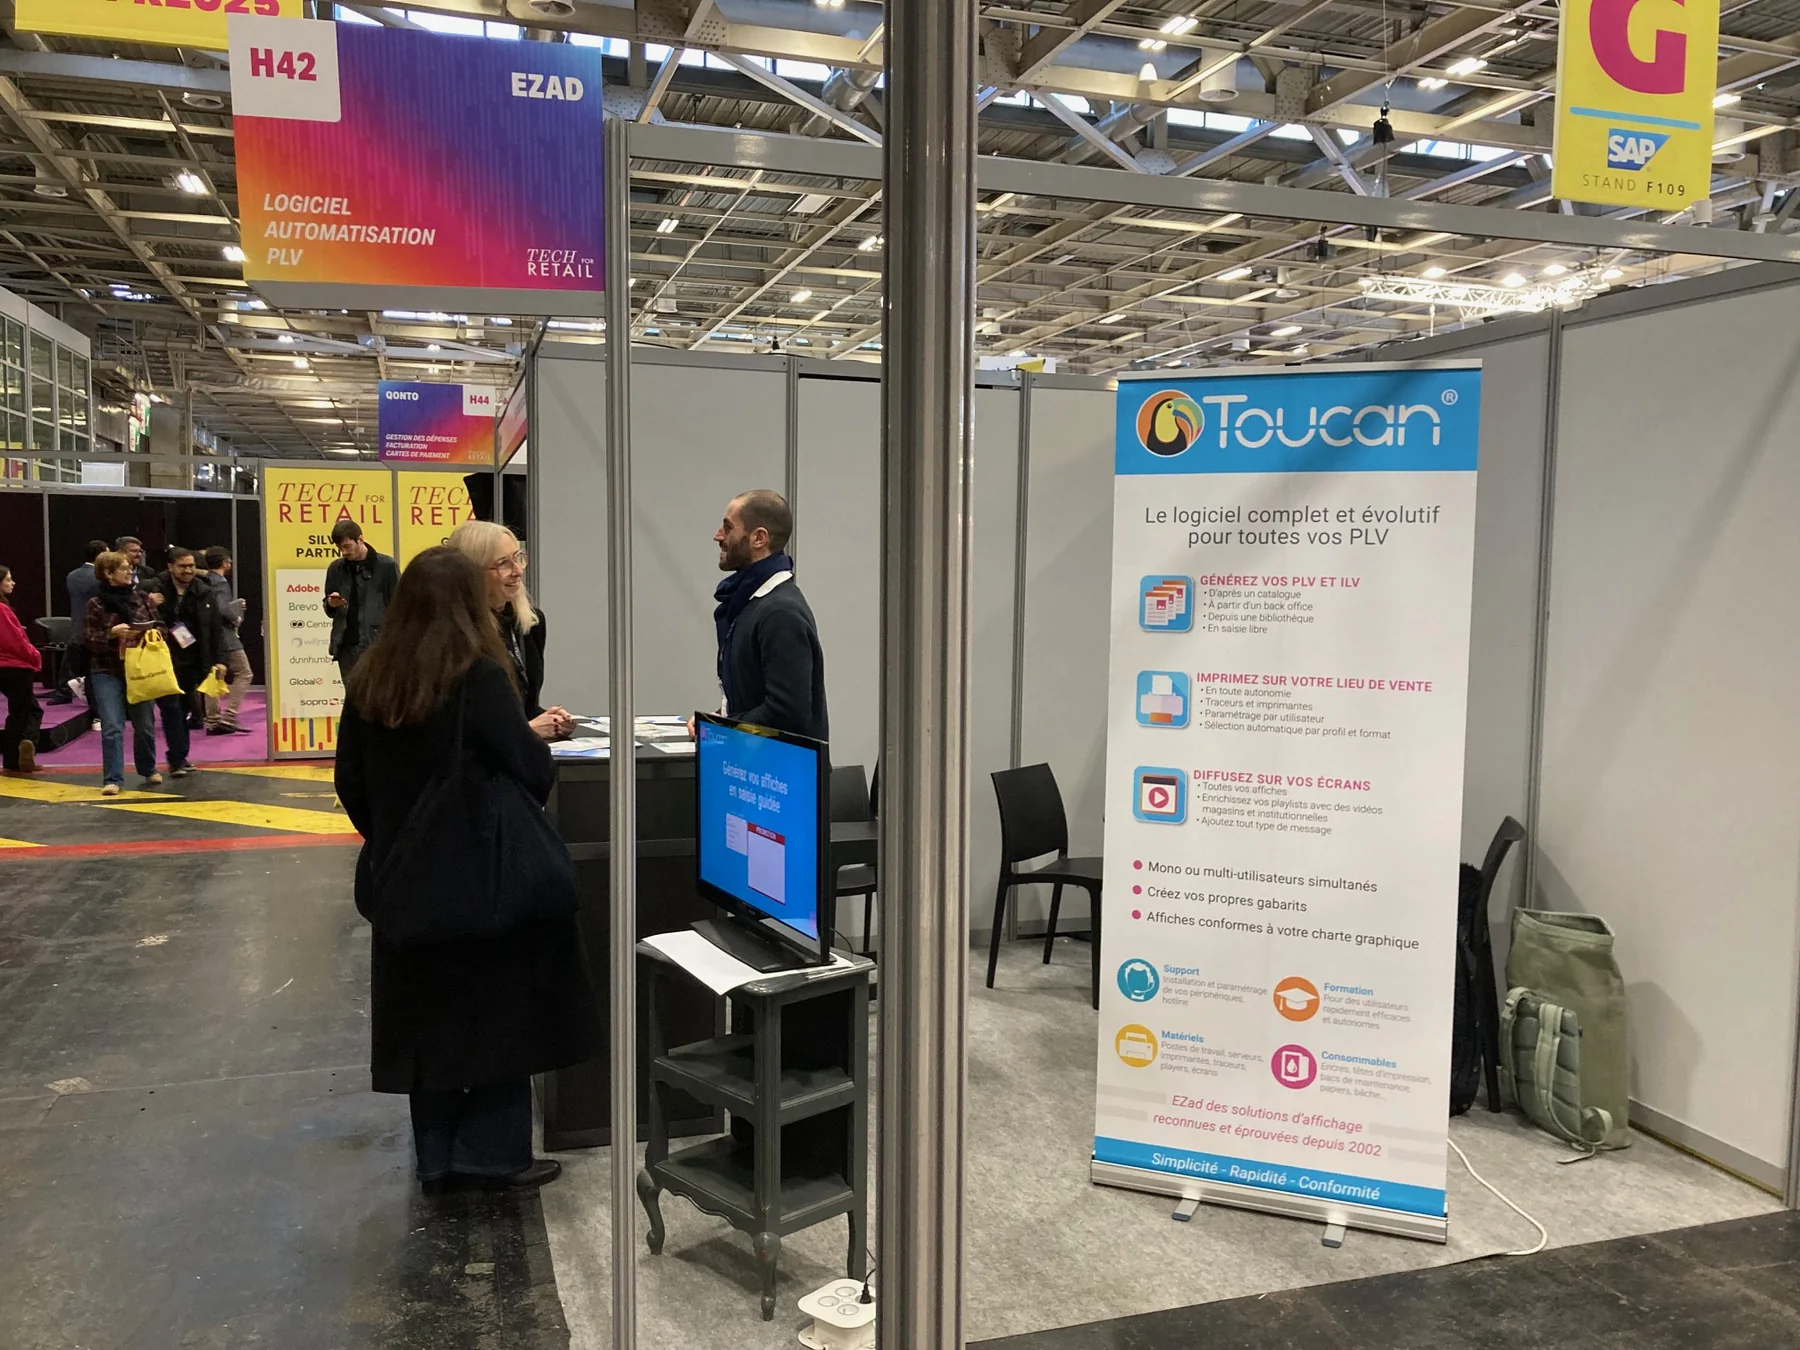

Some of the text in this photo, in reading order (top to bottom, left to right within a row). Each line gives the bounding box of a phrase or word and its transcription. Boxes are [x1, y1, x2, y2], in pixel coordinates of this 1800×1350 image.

[1589, 0, 1687, 94] G
[249, 47, 318, 82] H42
[510, 71, 584, 102] EZAD
[1609, 135, 1656, 164] SAP
[1582, 174, 1685, 196] STAND F109
[263, 194, 352, 217] LOGICIEL
[264, 222, 436, 246] AUTOMATISATION
[266, 248, 304, 266] PLV
[526, 248, 578, 264] TECH
[526, 262, 594, 279] RETAIL
[386, 391, 419, 400] QONTO
[470, 395, 489, 404] H44
[1203, 394, 1440, 449] Toucan
[426, 434, 457, 442] DÉPENSES
[278, 483, 358, 502] TECH
[280, 504, 382, 523] RETAIL
[412, 507, 476, 525] RETA
[1145, 505, 1440, 527] Le logiciel complet et évolutif
[308, 535, 334, 545] SILV
[1188, 528, 1389, 548] pour toutes vos PLV
[296, 548, 341, 558] PARTN
[287, 584, 320, 592] Adobe
[1200, 574, 1360, 588] GÉNÉREZ VOS PLV ET ILV
[1209, 589, 1241, 600] D'après
[1257, 590, 1301, 600] catalogue
[289, 602, 318, 611] Brevo
[1208, 599, 1313, 612] À partir d'un back office
[1208, 613, 1238, 624] Depuis
[1259, 613, 1314, 624] bibliothèque
[1208, 624, 1267, 634] En saisie libre
[290, 656, 334, 665] dunnhumby
[1196, 672, 1432, 692] IMPRIMEZ SUR VOTRE LIEU DE VENTE
[1206, 687, 1291, 698] En toute autonomie
[1206, 698, 1313, 712] Traceurs et imprimantes
[1205, 710, 1324, 723] Paramétrage par utilisateur
[1204, 721, 1244, 732] Sélection
[1246, 723, 1302, 735] automatique
[1305, 727, 1319, 736] par
[1322, 727, 1345, 738] profil
[1359, 729, 1390, 739] format
[723, 760, 787, 795] Générez vos affiches
[1193, 770, 1371, 791] DIFFUSEZ SUR VOS ÉCRANS
[1203, 782, 1287, 796] Toutes vos affiches
[729, 785, 780, 813] en saisie guidée
[1202, 794, 1383, 815] Enrichissez vos playlists avec des vidéos
[1202, 805, 1328, 823] magasins et institutionnelles
[1202, 817, 1332, 836] Ajoutez tout type de message
[1148, 862, 1377, 892] Mono ou multi-utilisateurs simultanés
[1148, 886, 1307, 912] Créez vos propres gabarits
[1147, 911, 1419, 950] Affiches conformes à votre charte graphique
[1164, 964, 1200, 975] Support
[1324, 983, 1373, 996] Formation
[1161, 1031, 1204, 1042] Matériels
[1322, 1051, 1397, 1068] Consommables
[1172, 1095, 1363, 1133] EZad des solutions d'affichage
[1153, 1114, 1381, 1156] reconnues et éprouvées depuis 2002
[1152, 1153, 1380, 1201] Simplicité Rapidité Conformité
